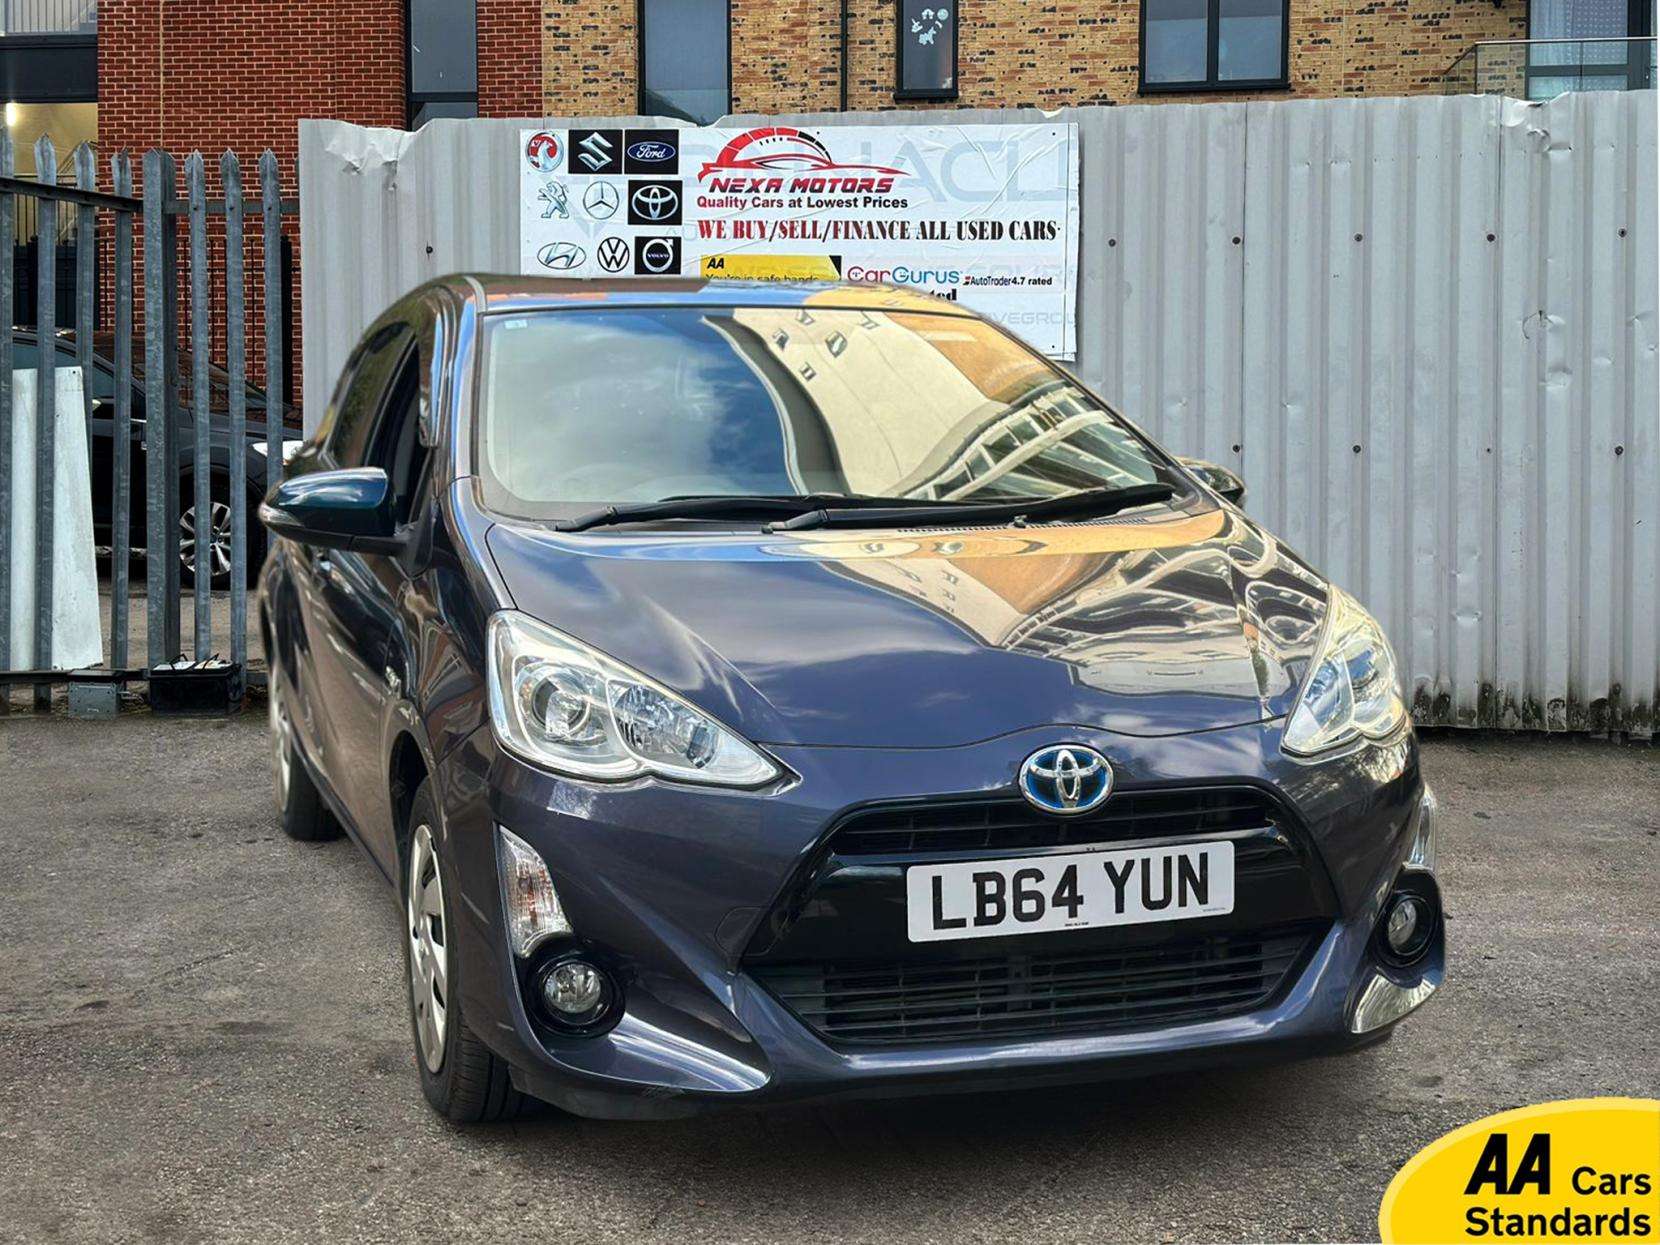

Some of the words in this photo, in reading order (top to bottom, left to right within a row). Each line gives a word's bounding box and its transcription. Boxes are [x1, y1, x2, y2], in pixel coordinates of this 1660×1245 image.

[636, 143, 666, 158] Ford
[709, 178, 783, 193] NEXA
[790, 178, 894, 193] MOTORS
[697, 196, 747, 210] Quality
[752, 197, 783, 208] Cars
[788, 197, 802, 208] at
[807, 197, 858, 208] Lowest
[863, 197, 908, 208] Prices
[697, 220, 726, 239] WE
[916, 220, 950, 240] ALL
[957, 220, 1003, 240] USED
[1009, 220, 1057, 240] CARS
[707, 258, 724, 269] AA
[848, 266, 960, 284] CarGurus
[1028, 277, 1052, 285] rated
[931, 864, 1084, 930] LB64
[1104, 852, 1208, 914] YUN
